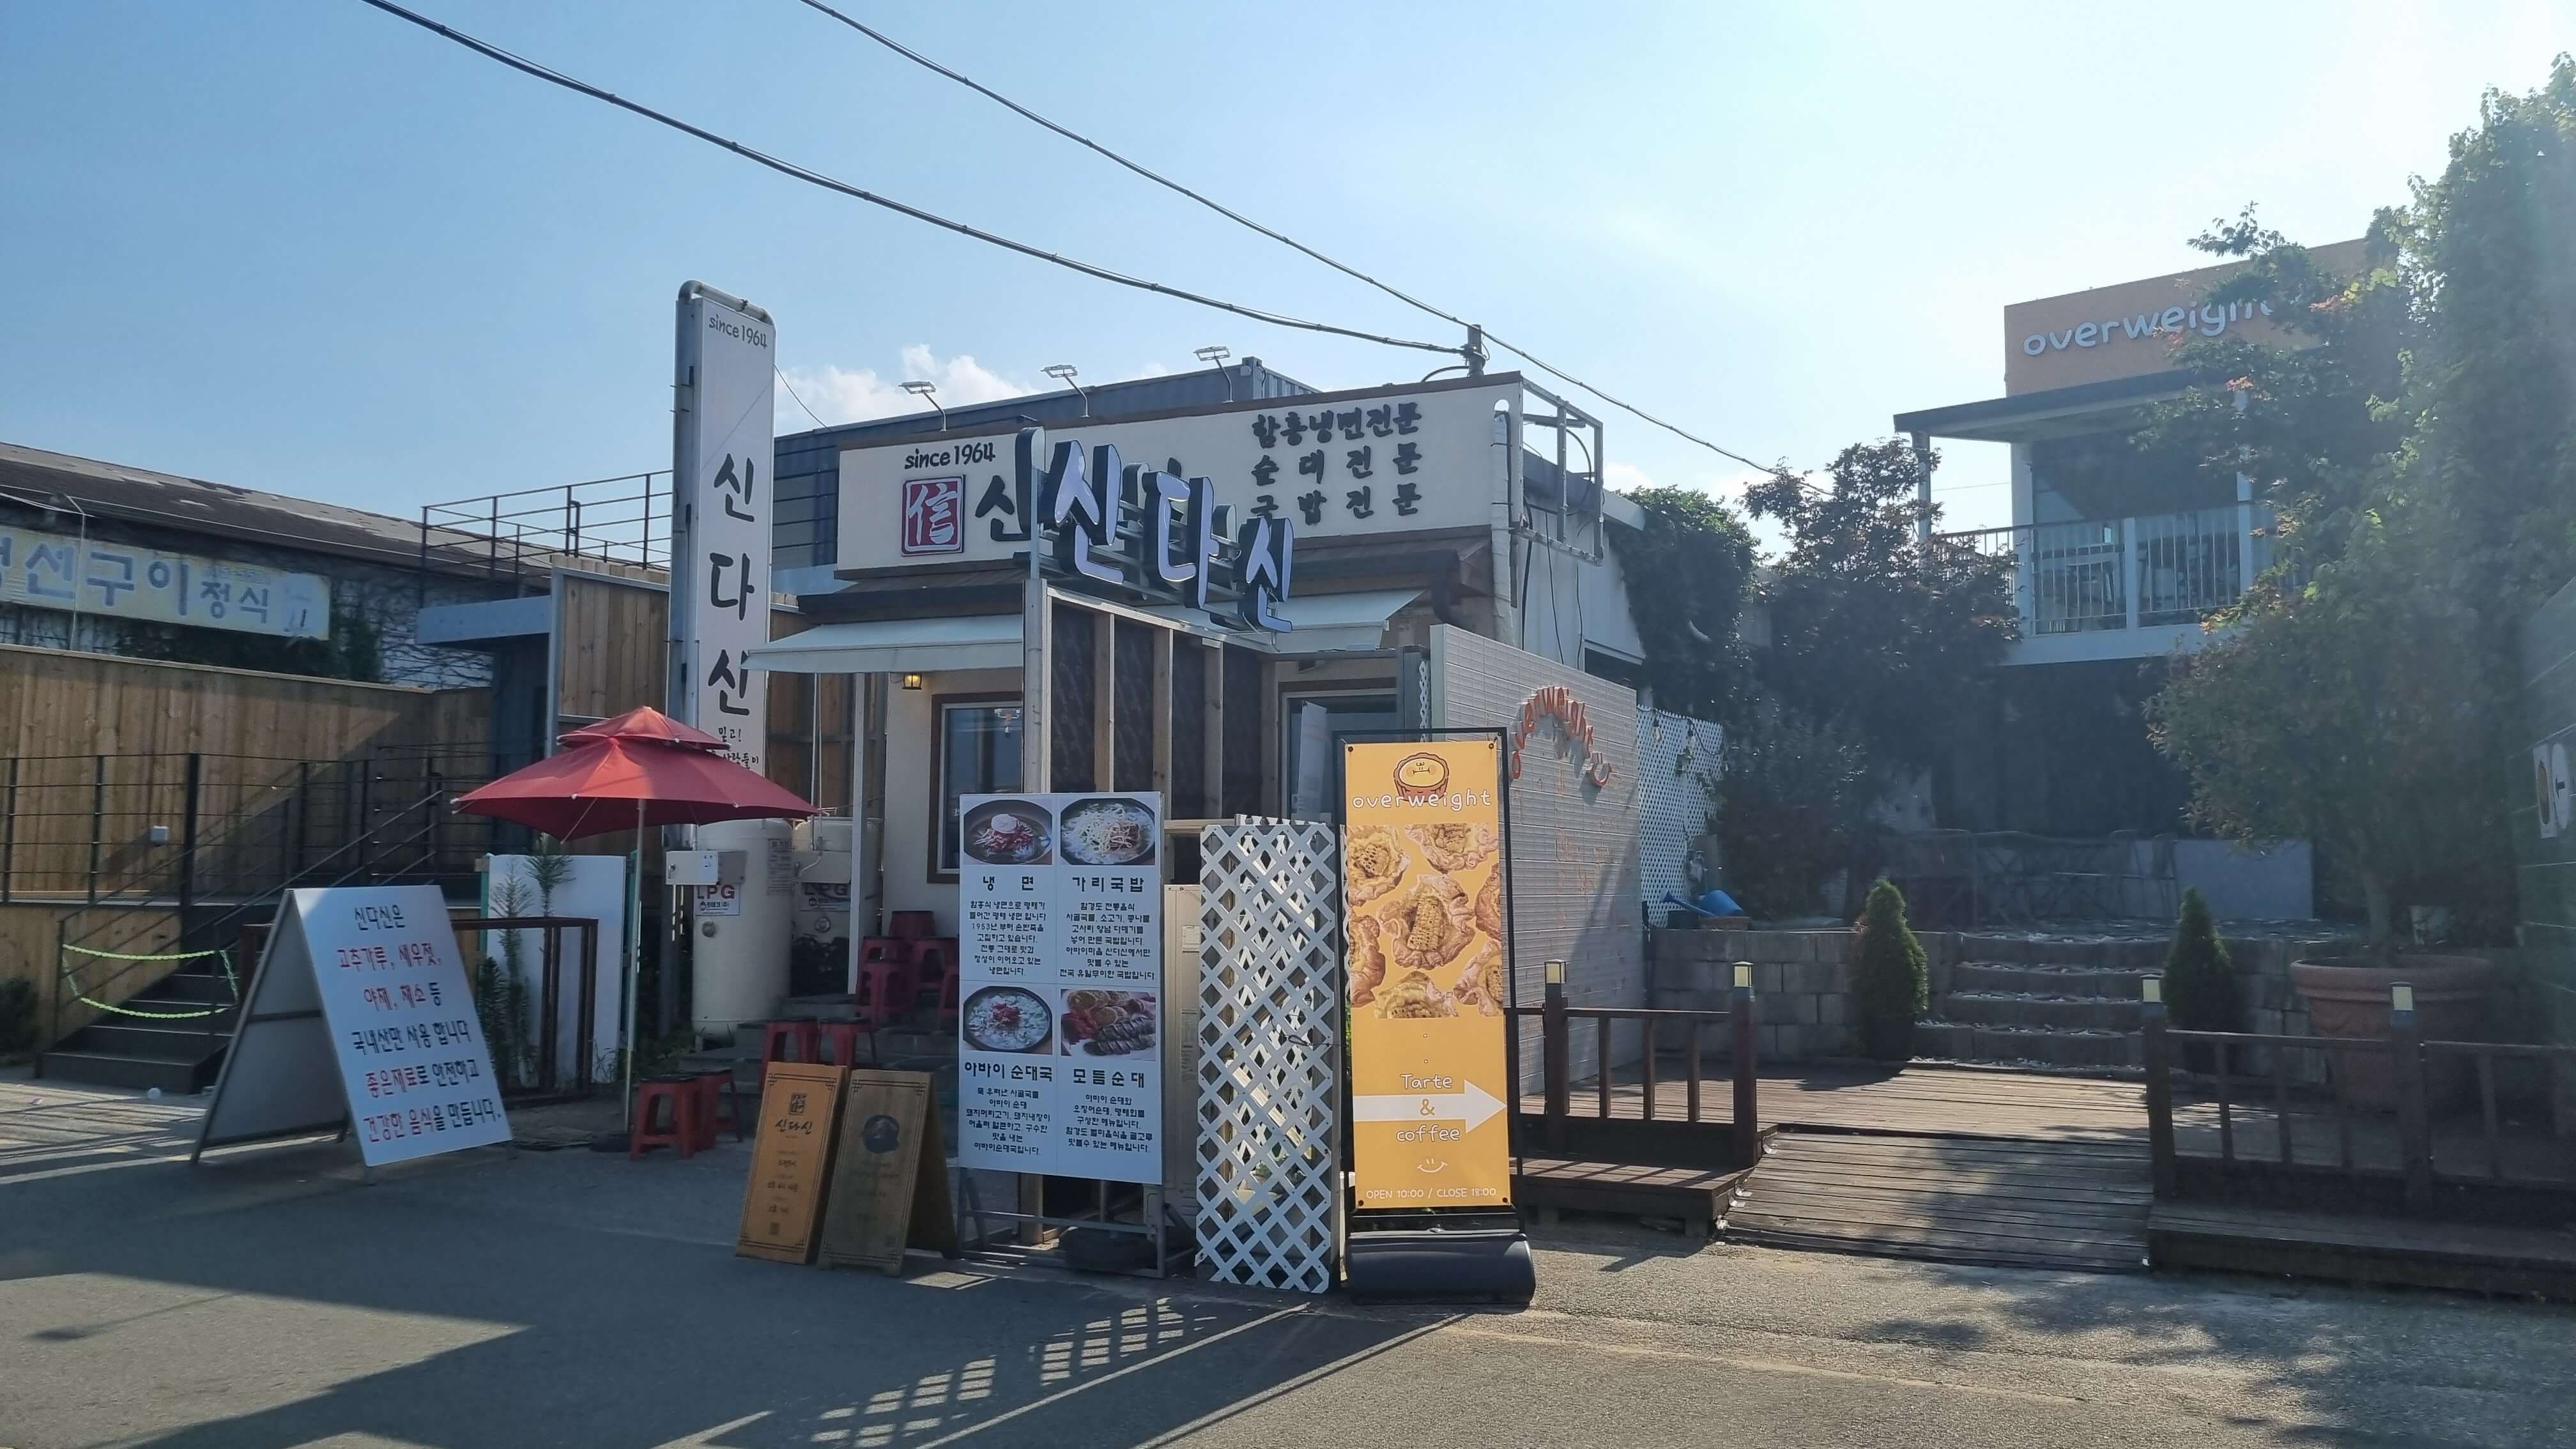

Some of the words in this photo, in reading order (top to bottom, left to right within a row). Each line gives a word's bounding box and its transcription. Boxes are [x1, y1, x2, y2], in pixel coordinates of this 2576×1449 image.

[709, 314, 739, 338] since
[741, 325, 767, 349] 1964
[905, 448, 951, 469] since
[954, 442, 995, 465] 1964
[1050, 440, 1294, 633] 신다신
[0, 537, 190, 616] 선구이
[200, 580, 269, 624] 정식
[1353, 788, 1492, 812] overweight
[1073, 877, 1144, 893] 가리국밥
[351, 1027, 404, 1055] 국내산만
[965, 1062, 1005, 1078] 아바이
[1011, 1065, 1052, 1082] 순대국
[1073, 1069, 1144, 1088] 모듬순대
[1400, 1073, 1453, 1090] Tarte
[1420, 1099, 1435, 1116] &
[1396, 1124, 1460, 1142] coffee
[1366, 1190, 1393, 1199] OPEN
[1397, 1190, 1424, 1198] 10:00
[1437, 1188, 1467, 1197] CLOSE
[1471, 1188, 1496, 1196] 18:00
